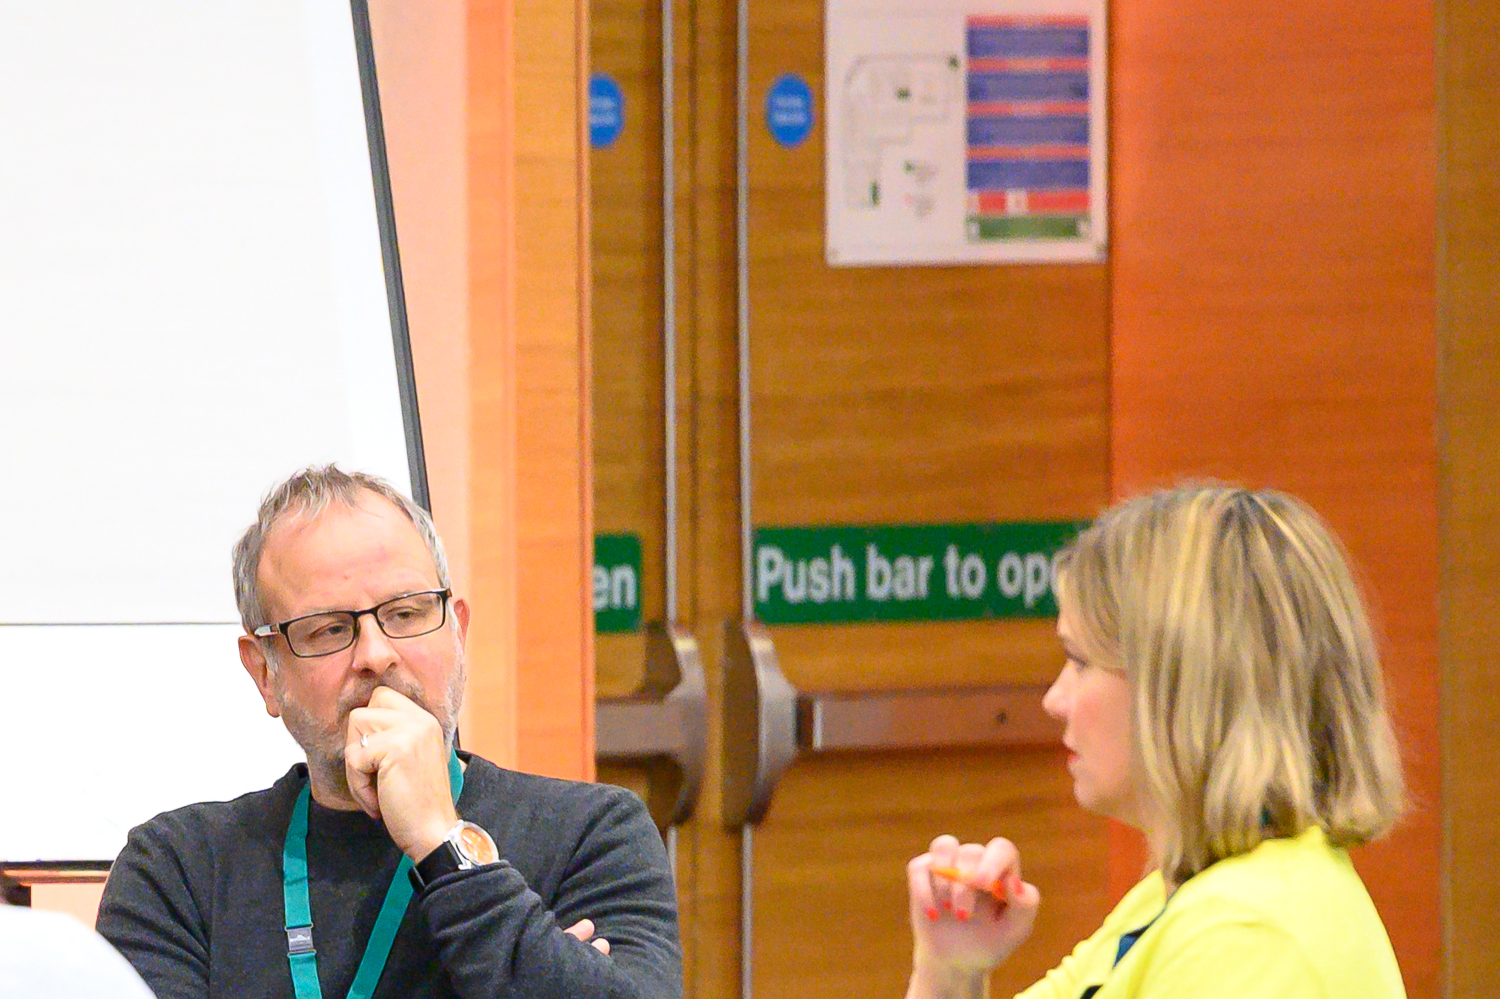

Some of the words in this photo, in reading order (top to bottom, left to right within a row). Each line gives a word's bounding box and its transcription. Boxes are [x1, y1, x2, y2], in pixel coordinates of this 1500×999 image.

[757, 544, 856, 604] Push
[866, 543, 934, 601] bar
[943, 544, 987, 599] to
